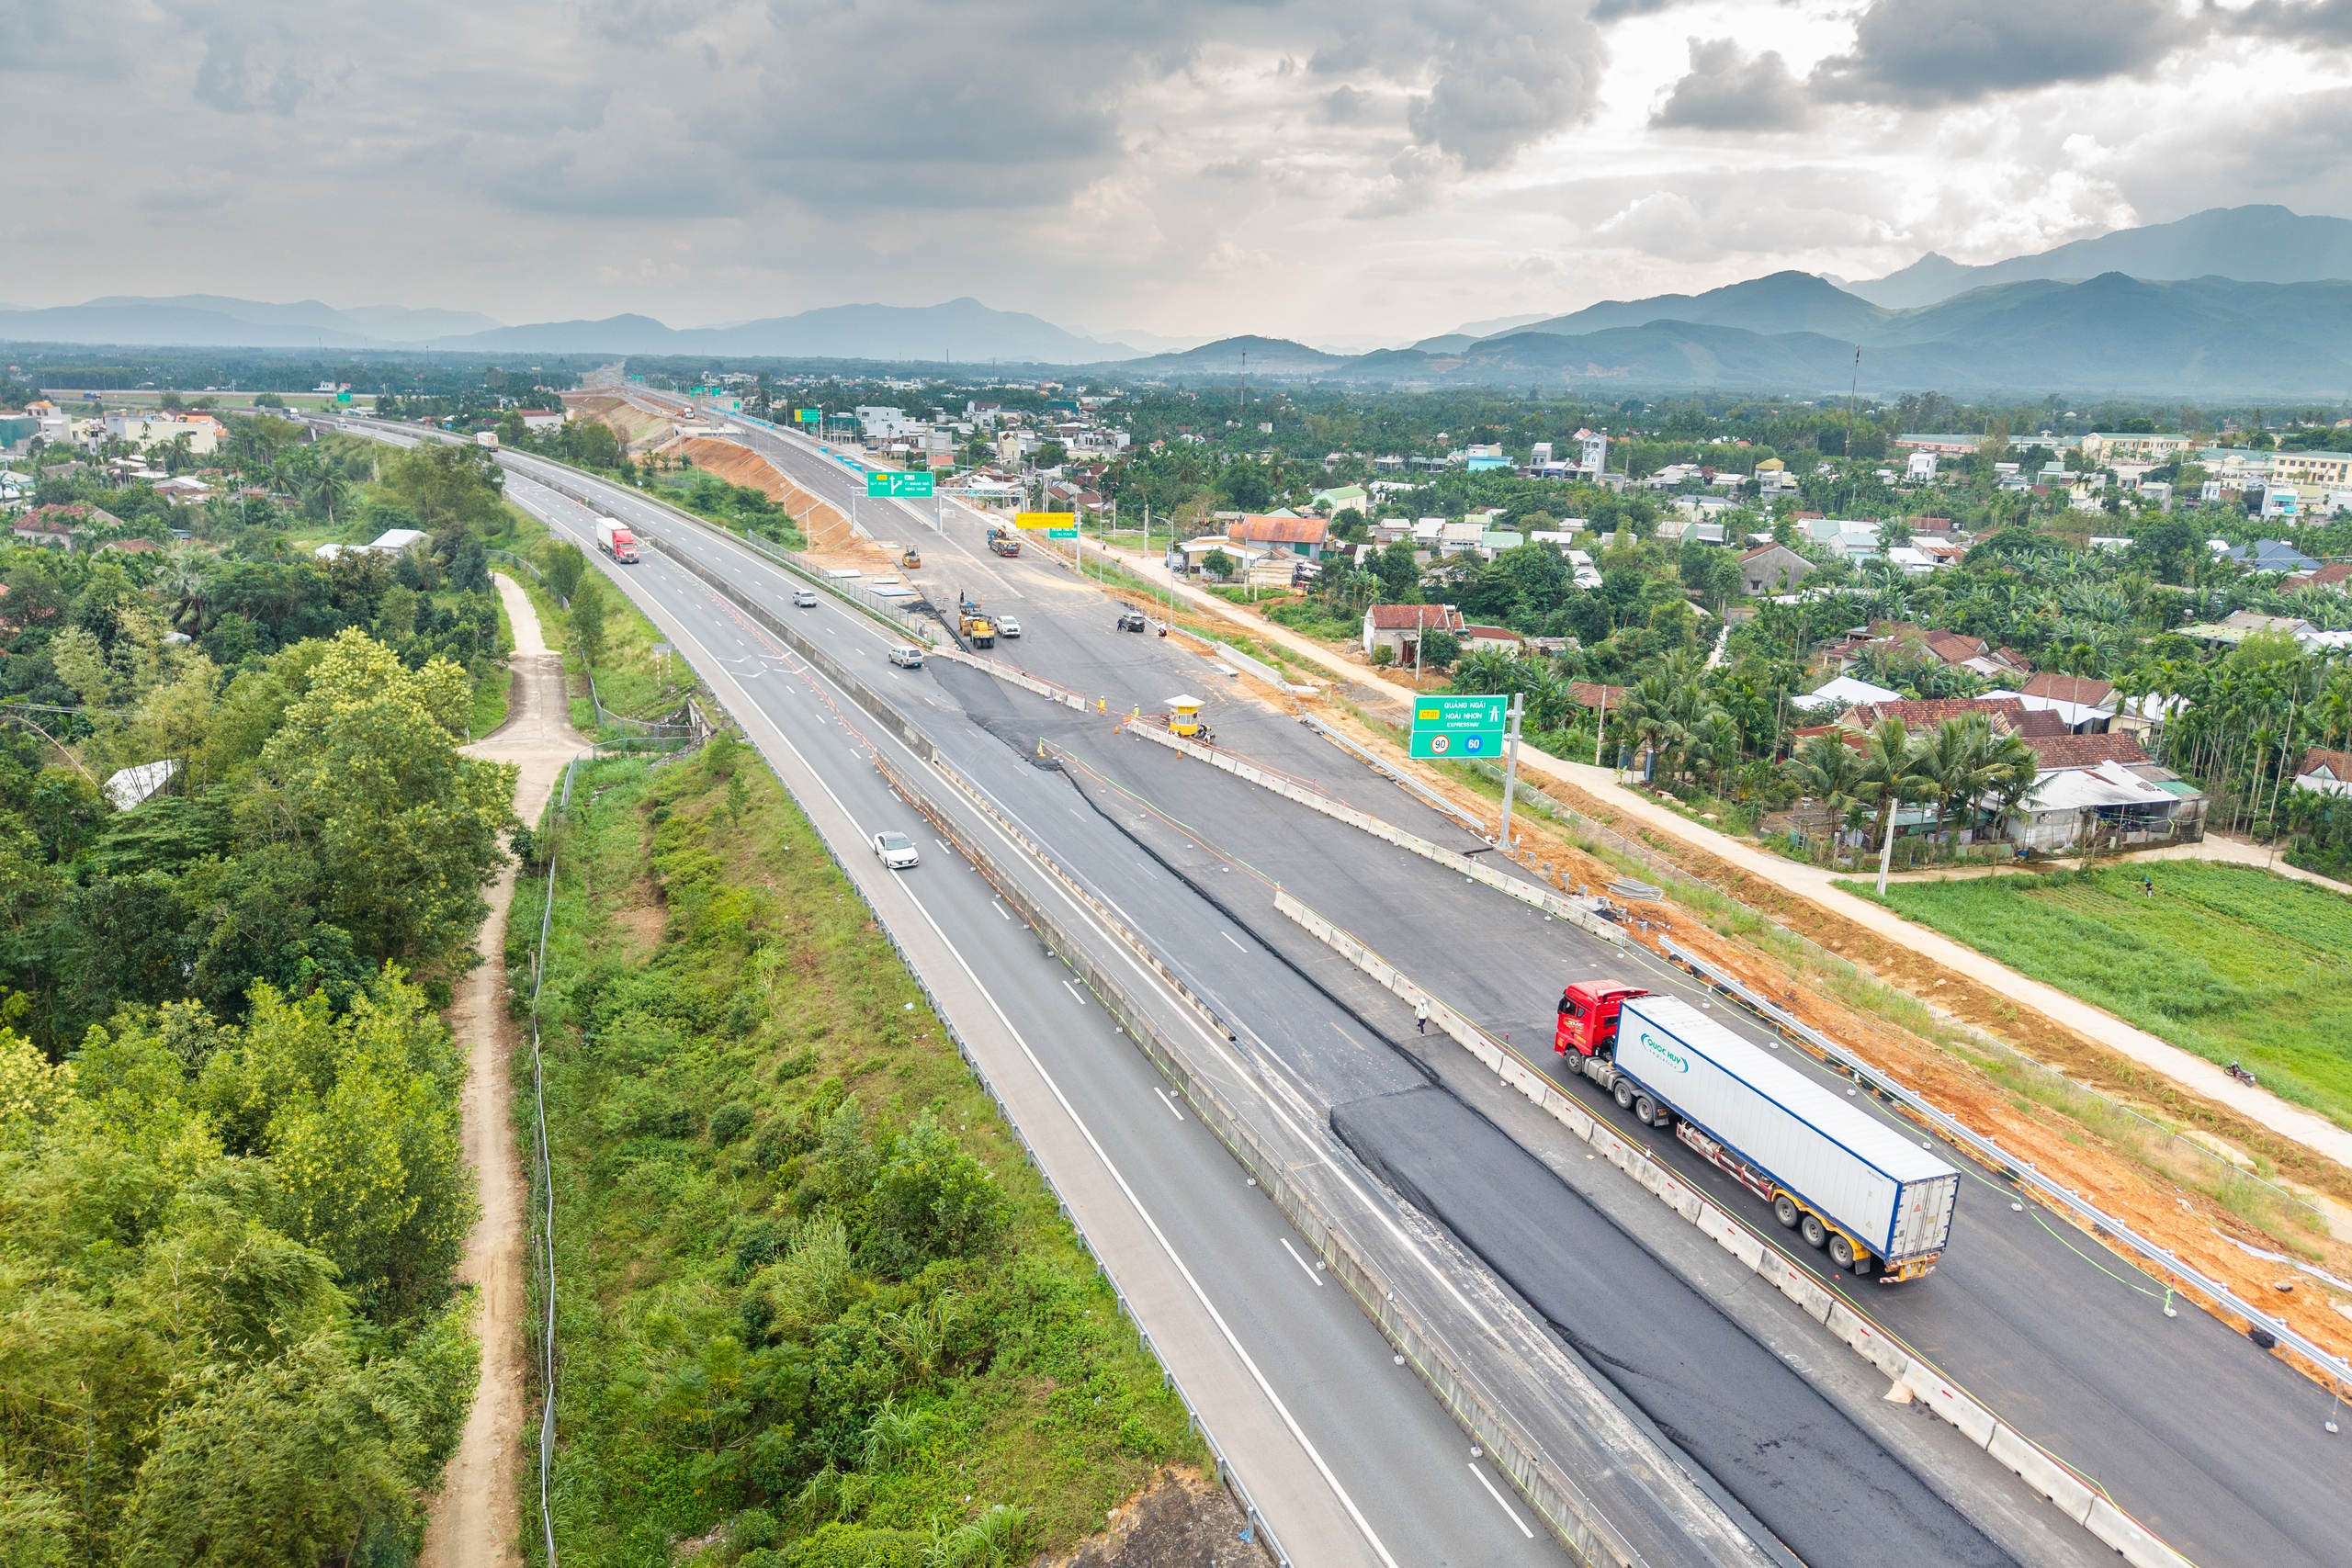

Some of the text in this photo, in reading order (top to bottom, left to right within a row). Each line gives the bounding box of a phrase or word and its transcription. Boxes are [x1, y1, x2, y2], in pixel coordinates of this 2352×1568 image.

[1444, 700, 1467, 709] QUẢNG
[1435, 740, 1446, 749] 90
[1468, 739, 1480, 749] 60
[1667, 1051, 1681, 1064] HUY
